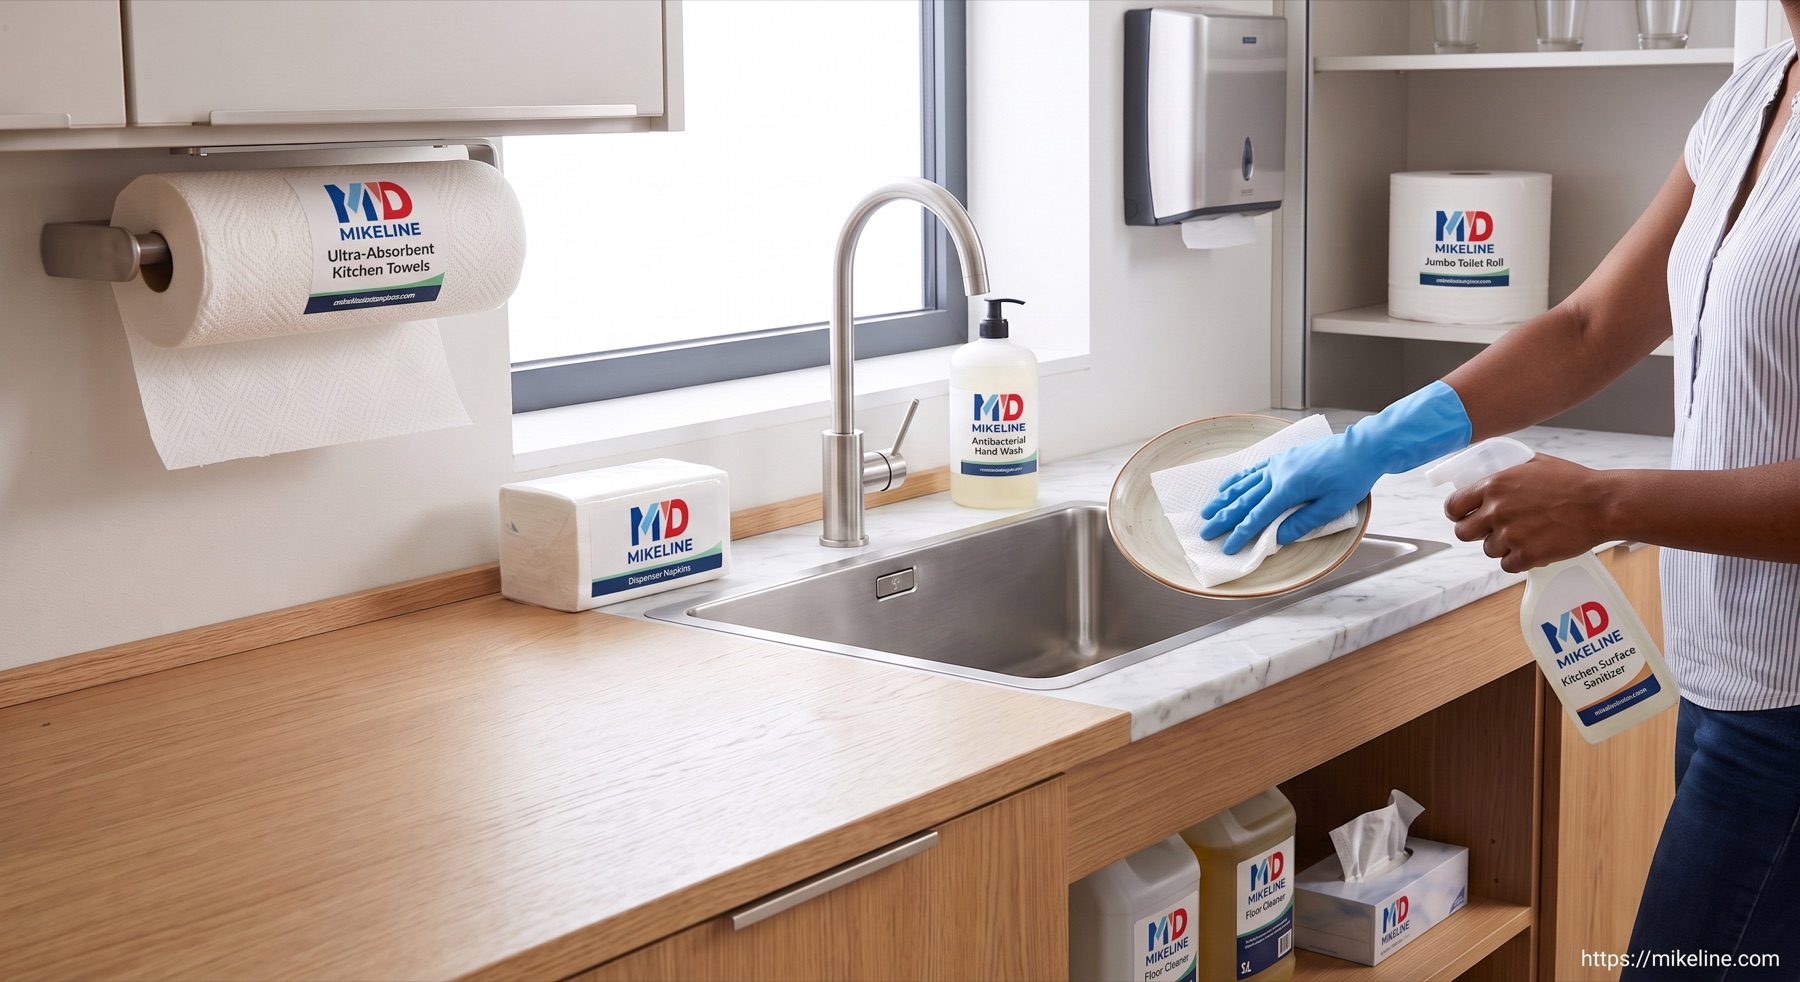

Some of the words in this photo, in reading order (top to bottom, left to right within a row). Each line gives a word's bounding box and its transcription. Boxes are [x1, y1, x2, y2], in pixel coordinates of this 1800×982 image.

[340, 222, 422, 241] MIKELINE
[328, 243, 435, 262] Ultra-Absorbent
[1435, 244, 1494, 254] MIKELINE
[332, 264, 383, 279] Kitchen
[386, 260, 430, 275] Towels
[1425, 257, 1456, 267] Jumbo
[1458, 259, 1484, 268] Toilet
[1486, 258, 1504, 267] Roll
[972, 422, 1026, 433] MIKELINE
[972, 436, 1026, 446] Antibacterial
[975, 447, 998, 456] Hand
[1000, 446, 1024, 455] Wash
[628, 538, 693, 565] MIKELINE
[628, 572, 662, 585] Dispenser
[664, 564, 691, 577] Napkins
[1556, 629, 1624, 669] MIKELINE
[1561, 664, 1599, 687] Kitchen
[1599, 647, 1636, 670] Surface
[1584, 664, 1626, 690] Sanitizer
[1248, 878, 1286, 905] MIKELINE
[1245, 906, 1262, 920] Floor
[1263, 893, 1286, 912] Cleaner
[1382, 920, 1410, 946] MIKELINE
[1146, 936, 1189, 966] MIKELINE
[1145, 967, 1163, 982] Floor
[1165, 954, 1189, 972] Cleaner
